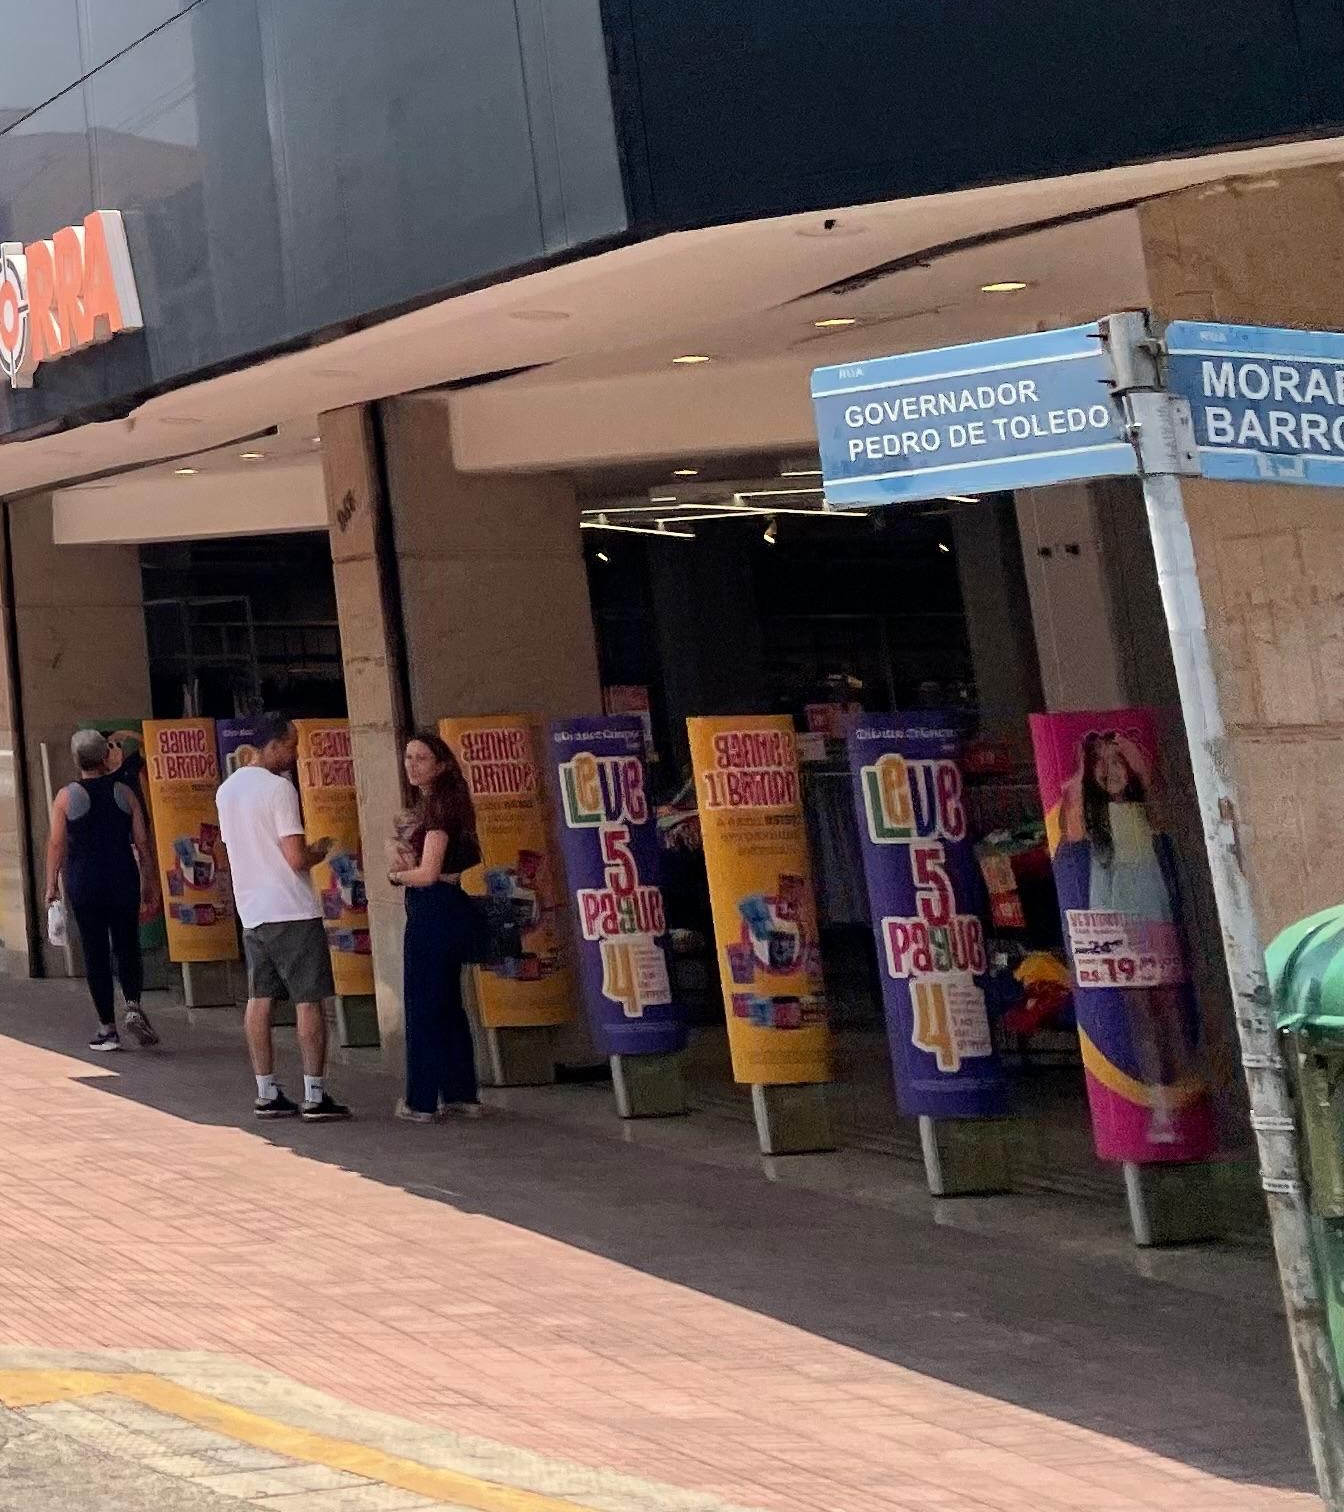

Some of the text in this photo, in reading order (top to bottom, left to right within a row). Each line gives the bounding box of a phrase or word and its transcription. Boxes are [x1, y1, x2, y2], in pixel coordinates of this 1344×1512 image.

[844, 380, 1040, 429] GOVERNADOR
[848, 404, 1109, 463] PEDRO DE TOLEDO
[603, 829, 638, 897] 5
[914, 847, 953, 926] 5
